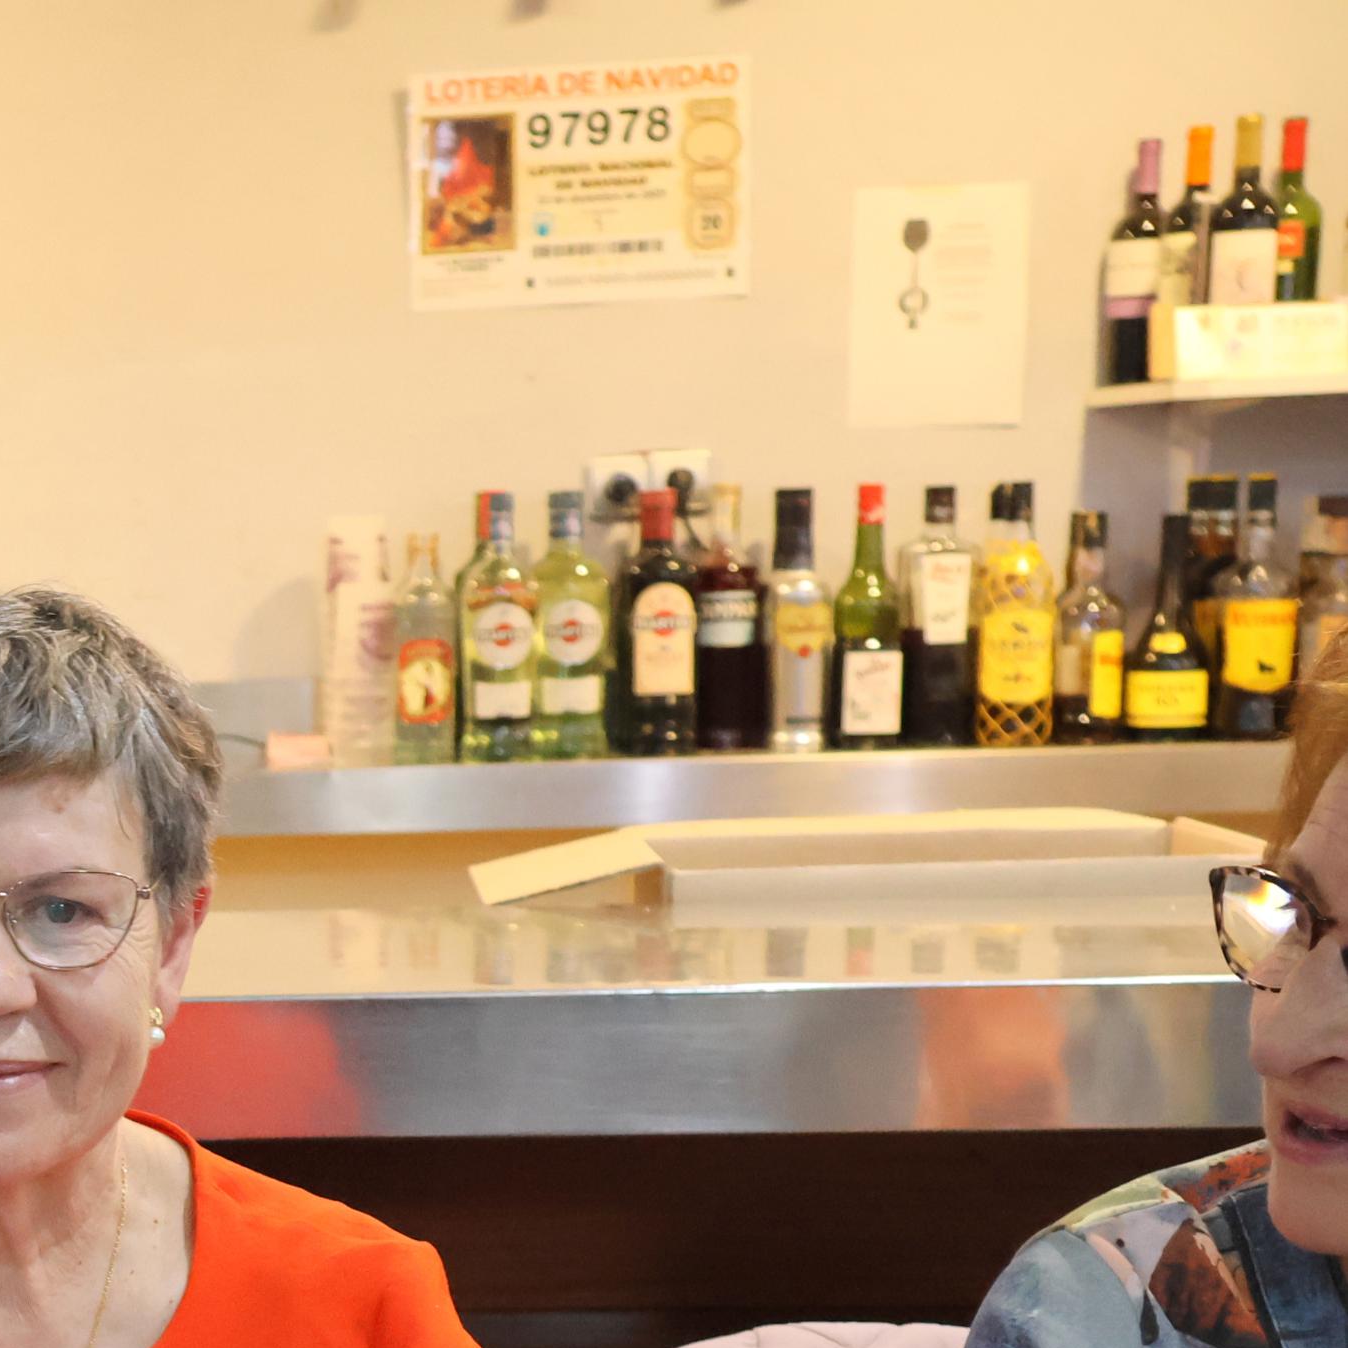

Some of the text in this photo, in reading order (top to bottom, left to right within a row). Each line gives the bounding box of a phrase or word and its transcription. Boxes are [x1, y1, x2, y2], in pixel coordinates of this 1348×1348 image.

[557, 70, 597, 95] DE
[605, 62, 740, 91] NAVIDAD
[527, 106, 672, 149] 97978
